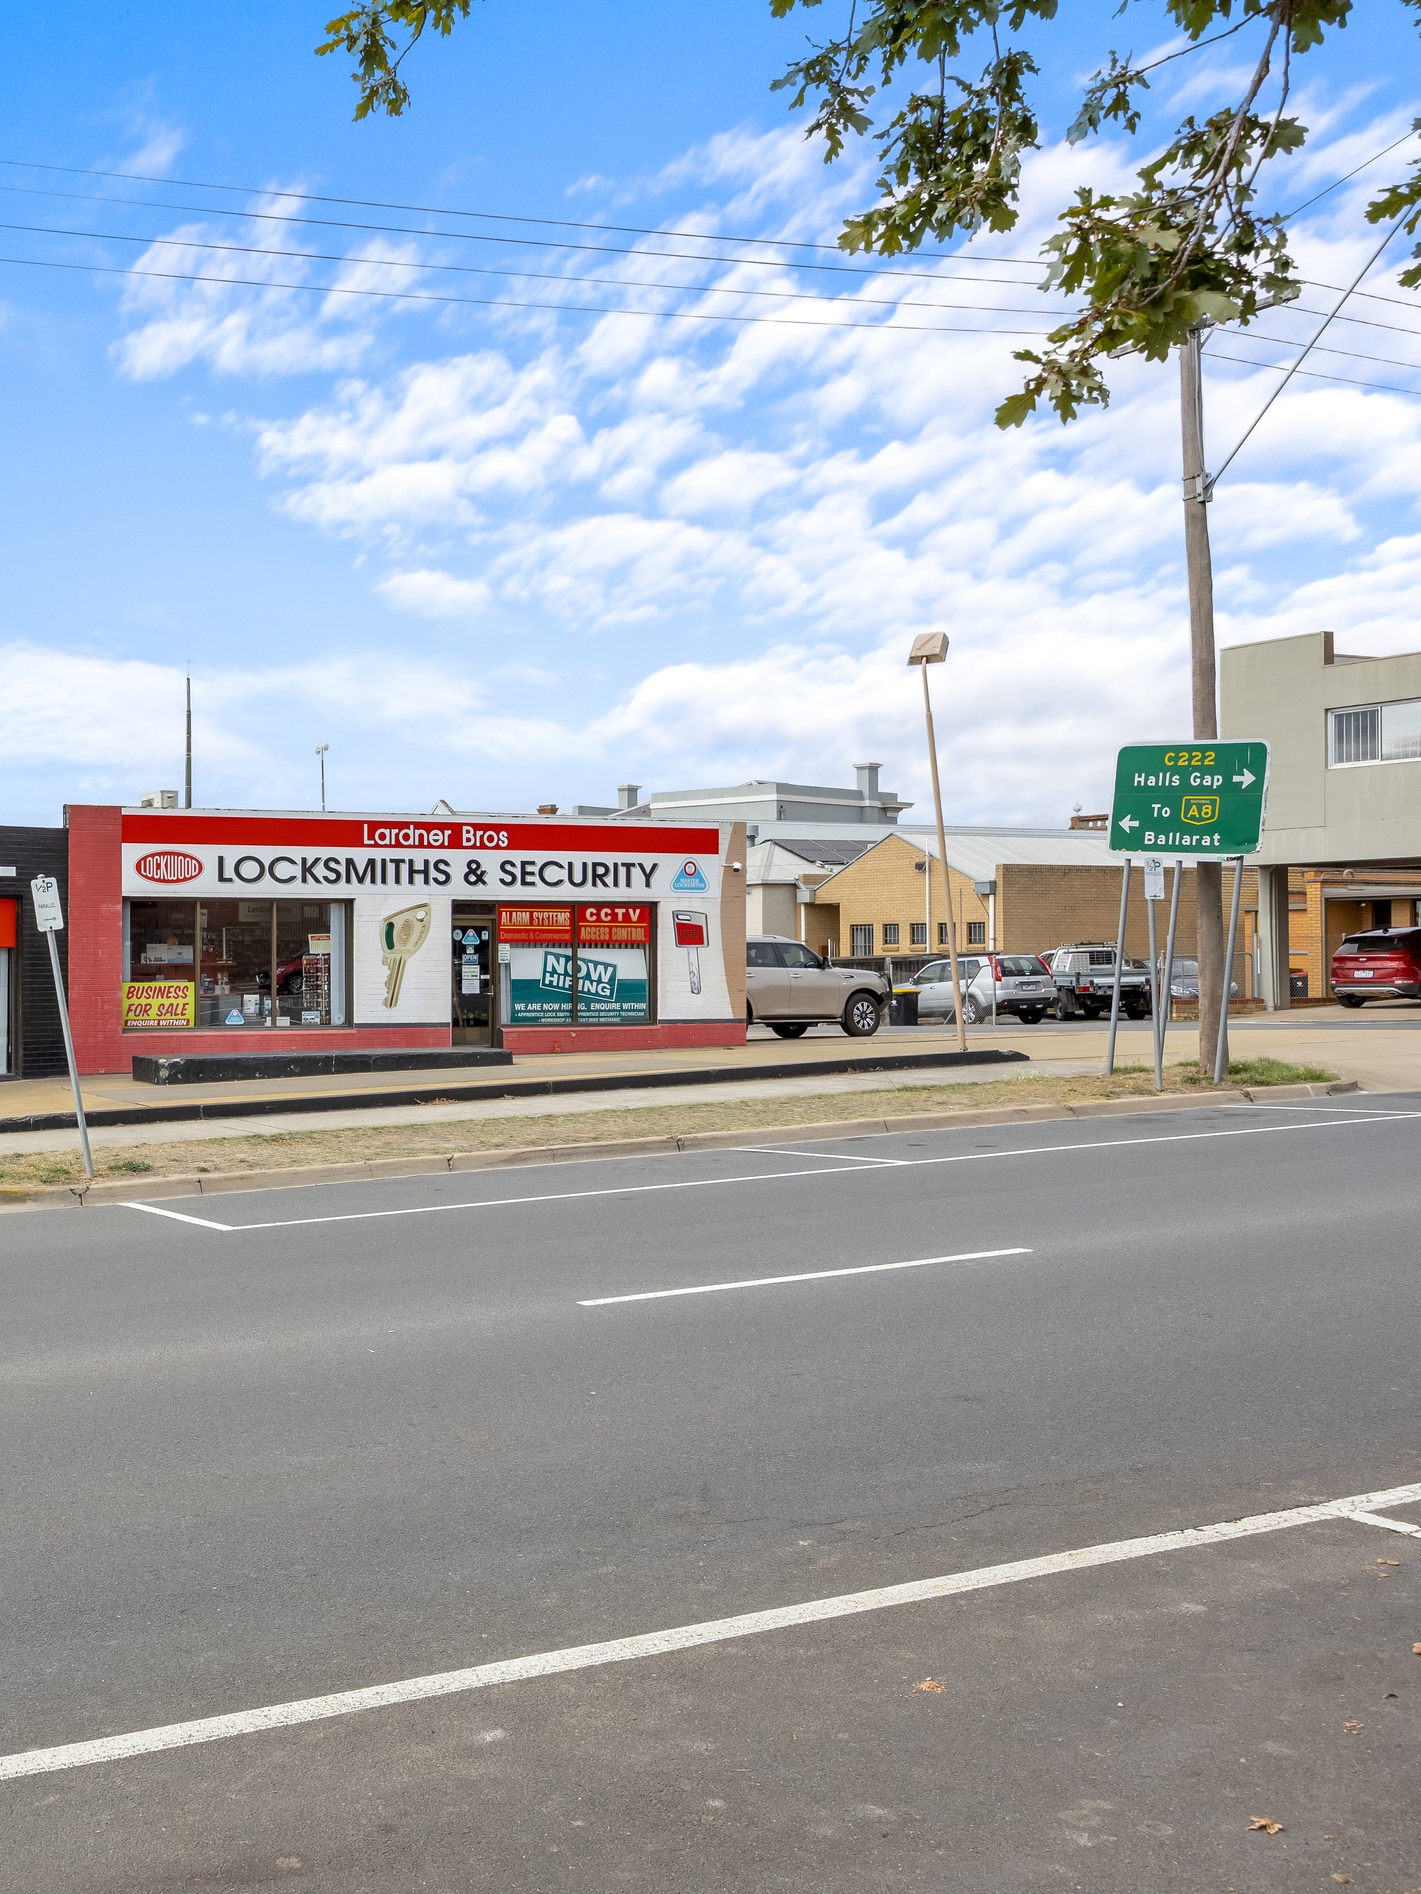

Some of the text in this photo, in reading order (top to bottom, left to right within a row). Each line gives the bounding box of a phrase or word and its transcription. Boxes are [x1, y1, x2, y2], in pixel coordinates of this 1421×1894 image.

[1164, 751, 1216, 766] C222
[1134, 772, 1223, 789] Halls Gap
[1152, 803, 1212, 818] To A8
[363, 823, 509, 848] Lardner Bros
[1144, 831, 1221, 846] Ballarat
[140, 854, 199, 881] LOCKWOOD
[217, 855, 660, 889] LOCKSMITHS & SECURITY
[501, 911, 570, 926] ALARM SYSTEMS
[585, 908, 641, 922] CCTV
[500, 931, 529, 939] Domestic
[535, 931, 571, 939] Commercial
[580, 927, 645, 941] ACCESS CONTROL
[546, 954, 614, 983] NOW
[544, 972, 611, 997] HIRING
[126, 985, 189, 1000] BUSINESS
[125, 1002, 190, 1018] FOR SALE
[590, 1002, 621, 1010] ENQUIRE
[622, 1002, 646, 1010] WITHIN
